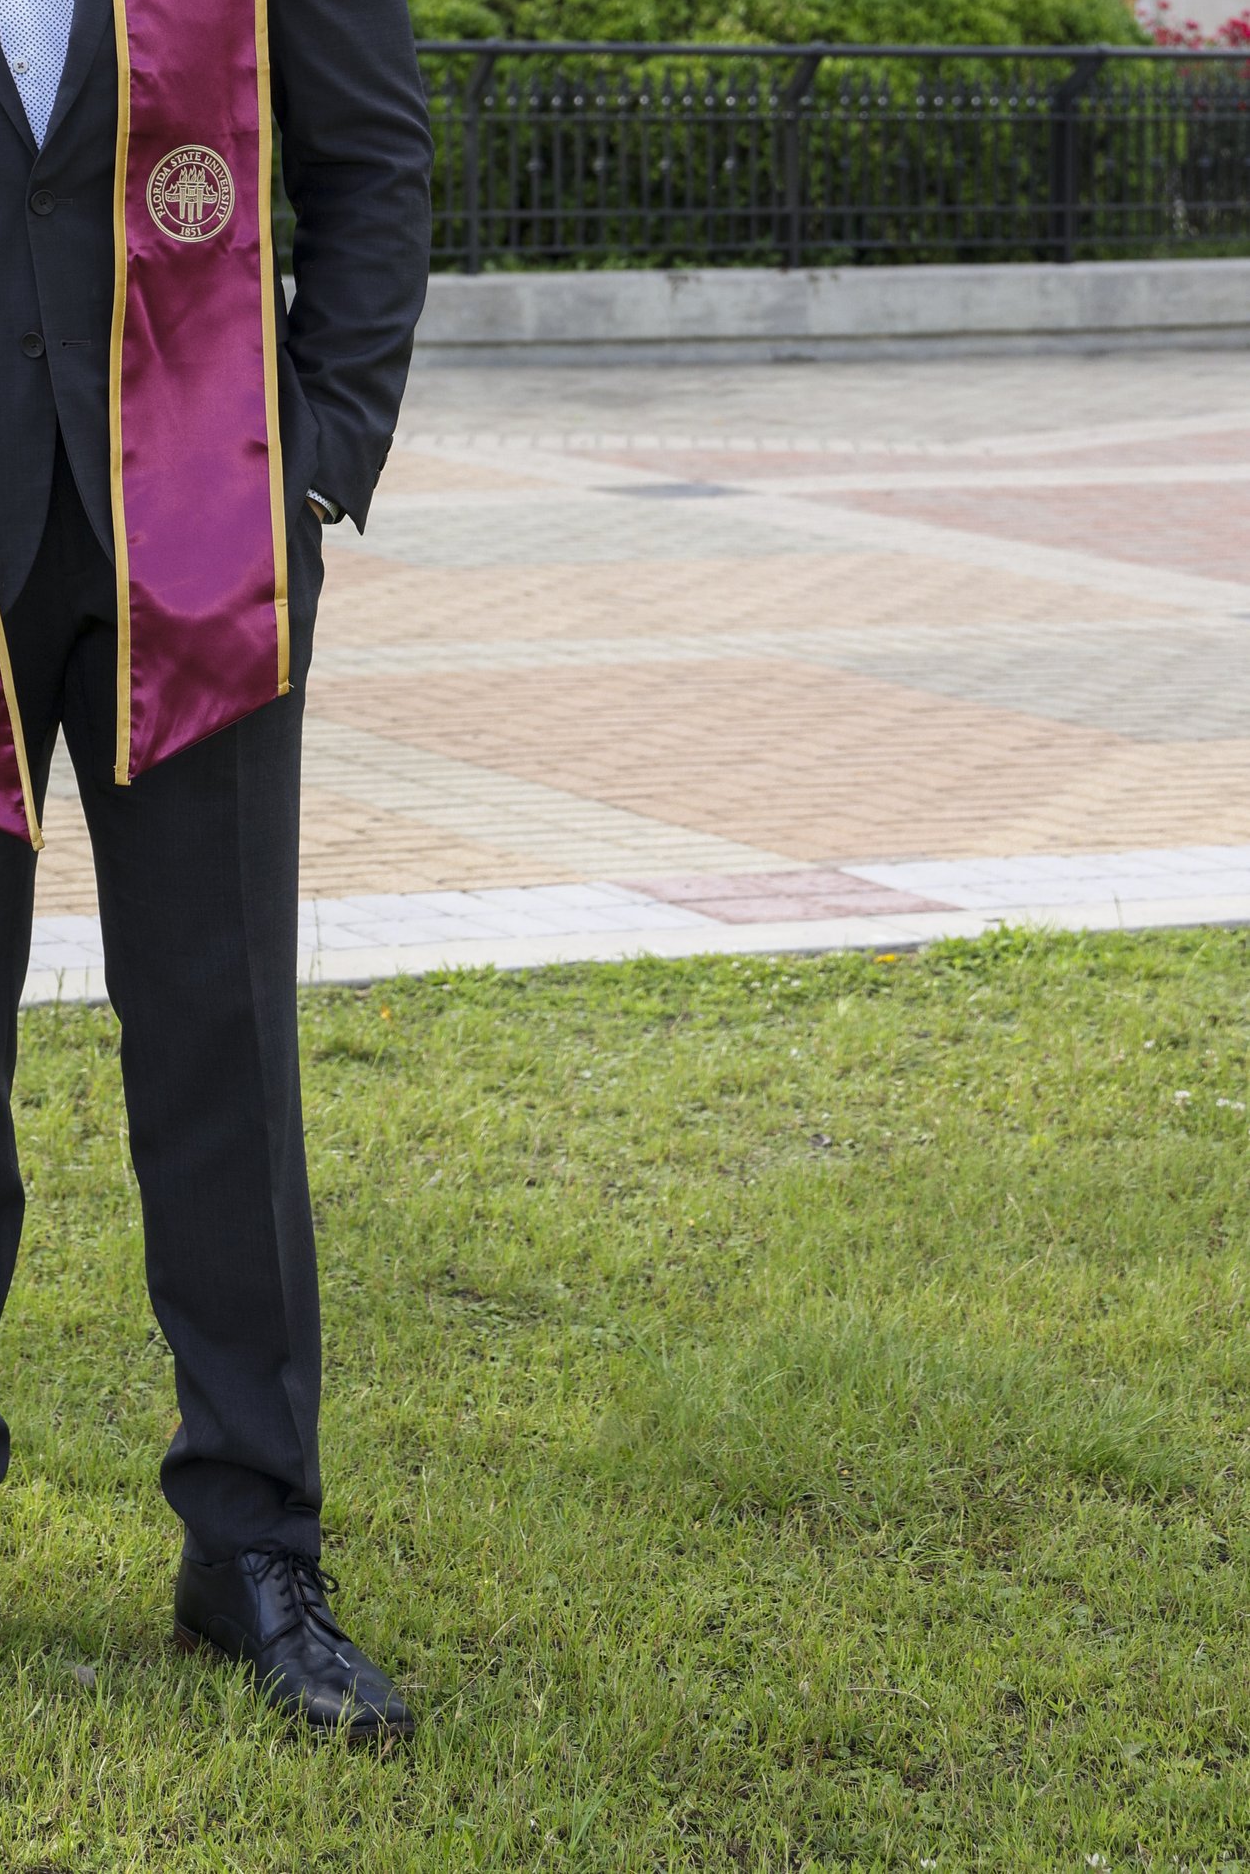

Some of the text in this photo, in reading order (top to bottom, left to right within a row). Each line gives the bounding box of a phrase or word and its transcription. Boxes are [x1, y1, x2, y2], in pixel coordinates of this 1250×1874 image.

[153, 152, 230, 221] FLORIDA STATE UNIVERSITY
[179, 227, 202, 237] 1851
